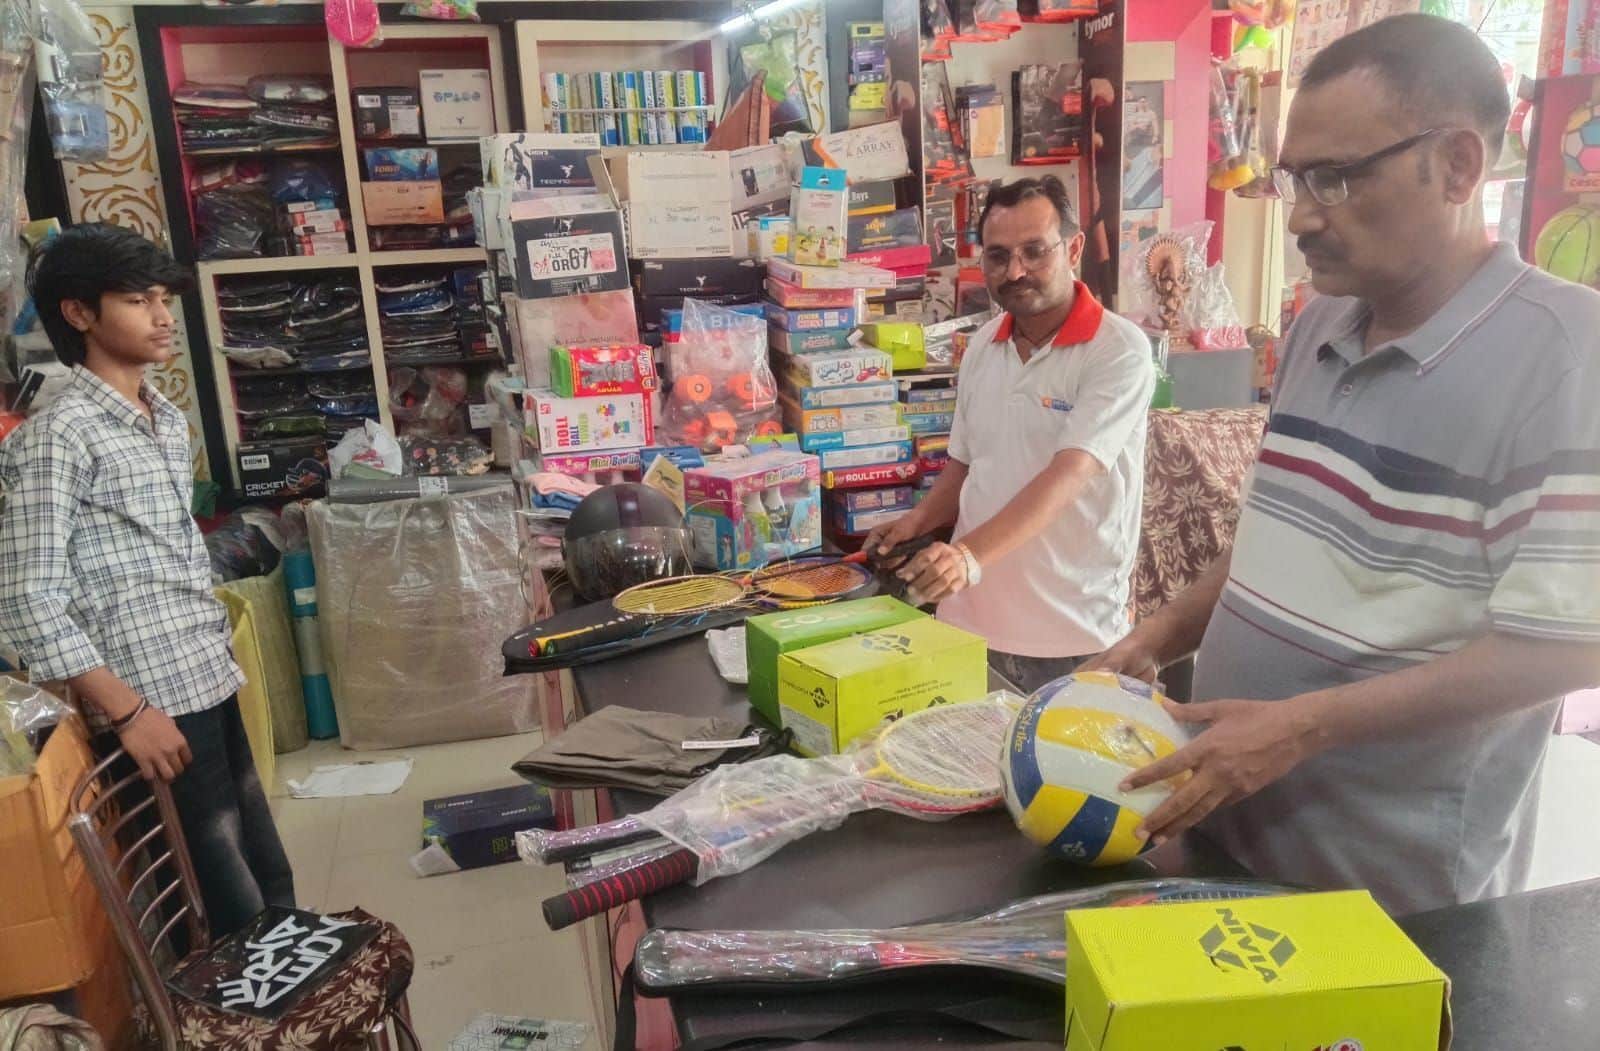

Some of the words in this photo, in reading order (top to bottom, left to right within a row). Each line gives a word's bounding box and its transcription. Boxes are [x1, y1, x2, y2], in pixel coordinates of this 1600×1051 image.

[1085, 12, 1114, 39] tynor
[856, 141, 894, 157] ARRAY
[555, 415, 570, 447] ROLL
[569, 425, 581, 446] BALL
[611, 454, 640, 467] Bowlin
[845, 469, 893, 483] ROULETTE
[245, 480, 285, 492] CRICKET
[246, 489, 276, 497] HELMET
[1215, 907, 1279, 984] NIVIA
